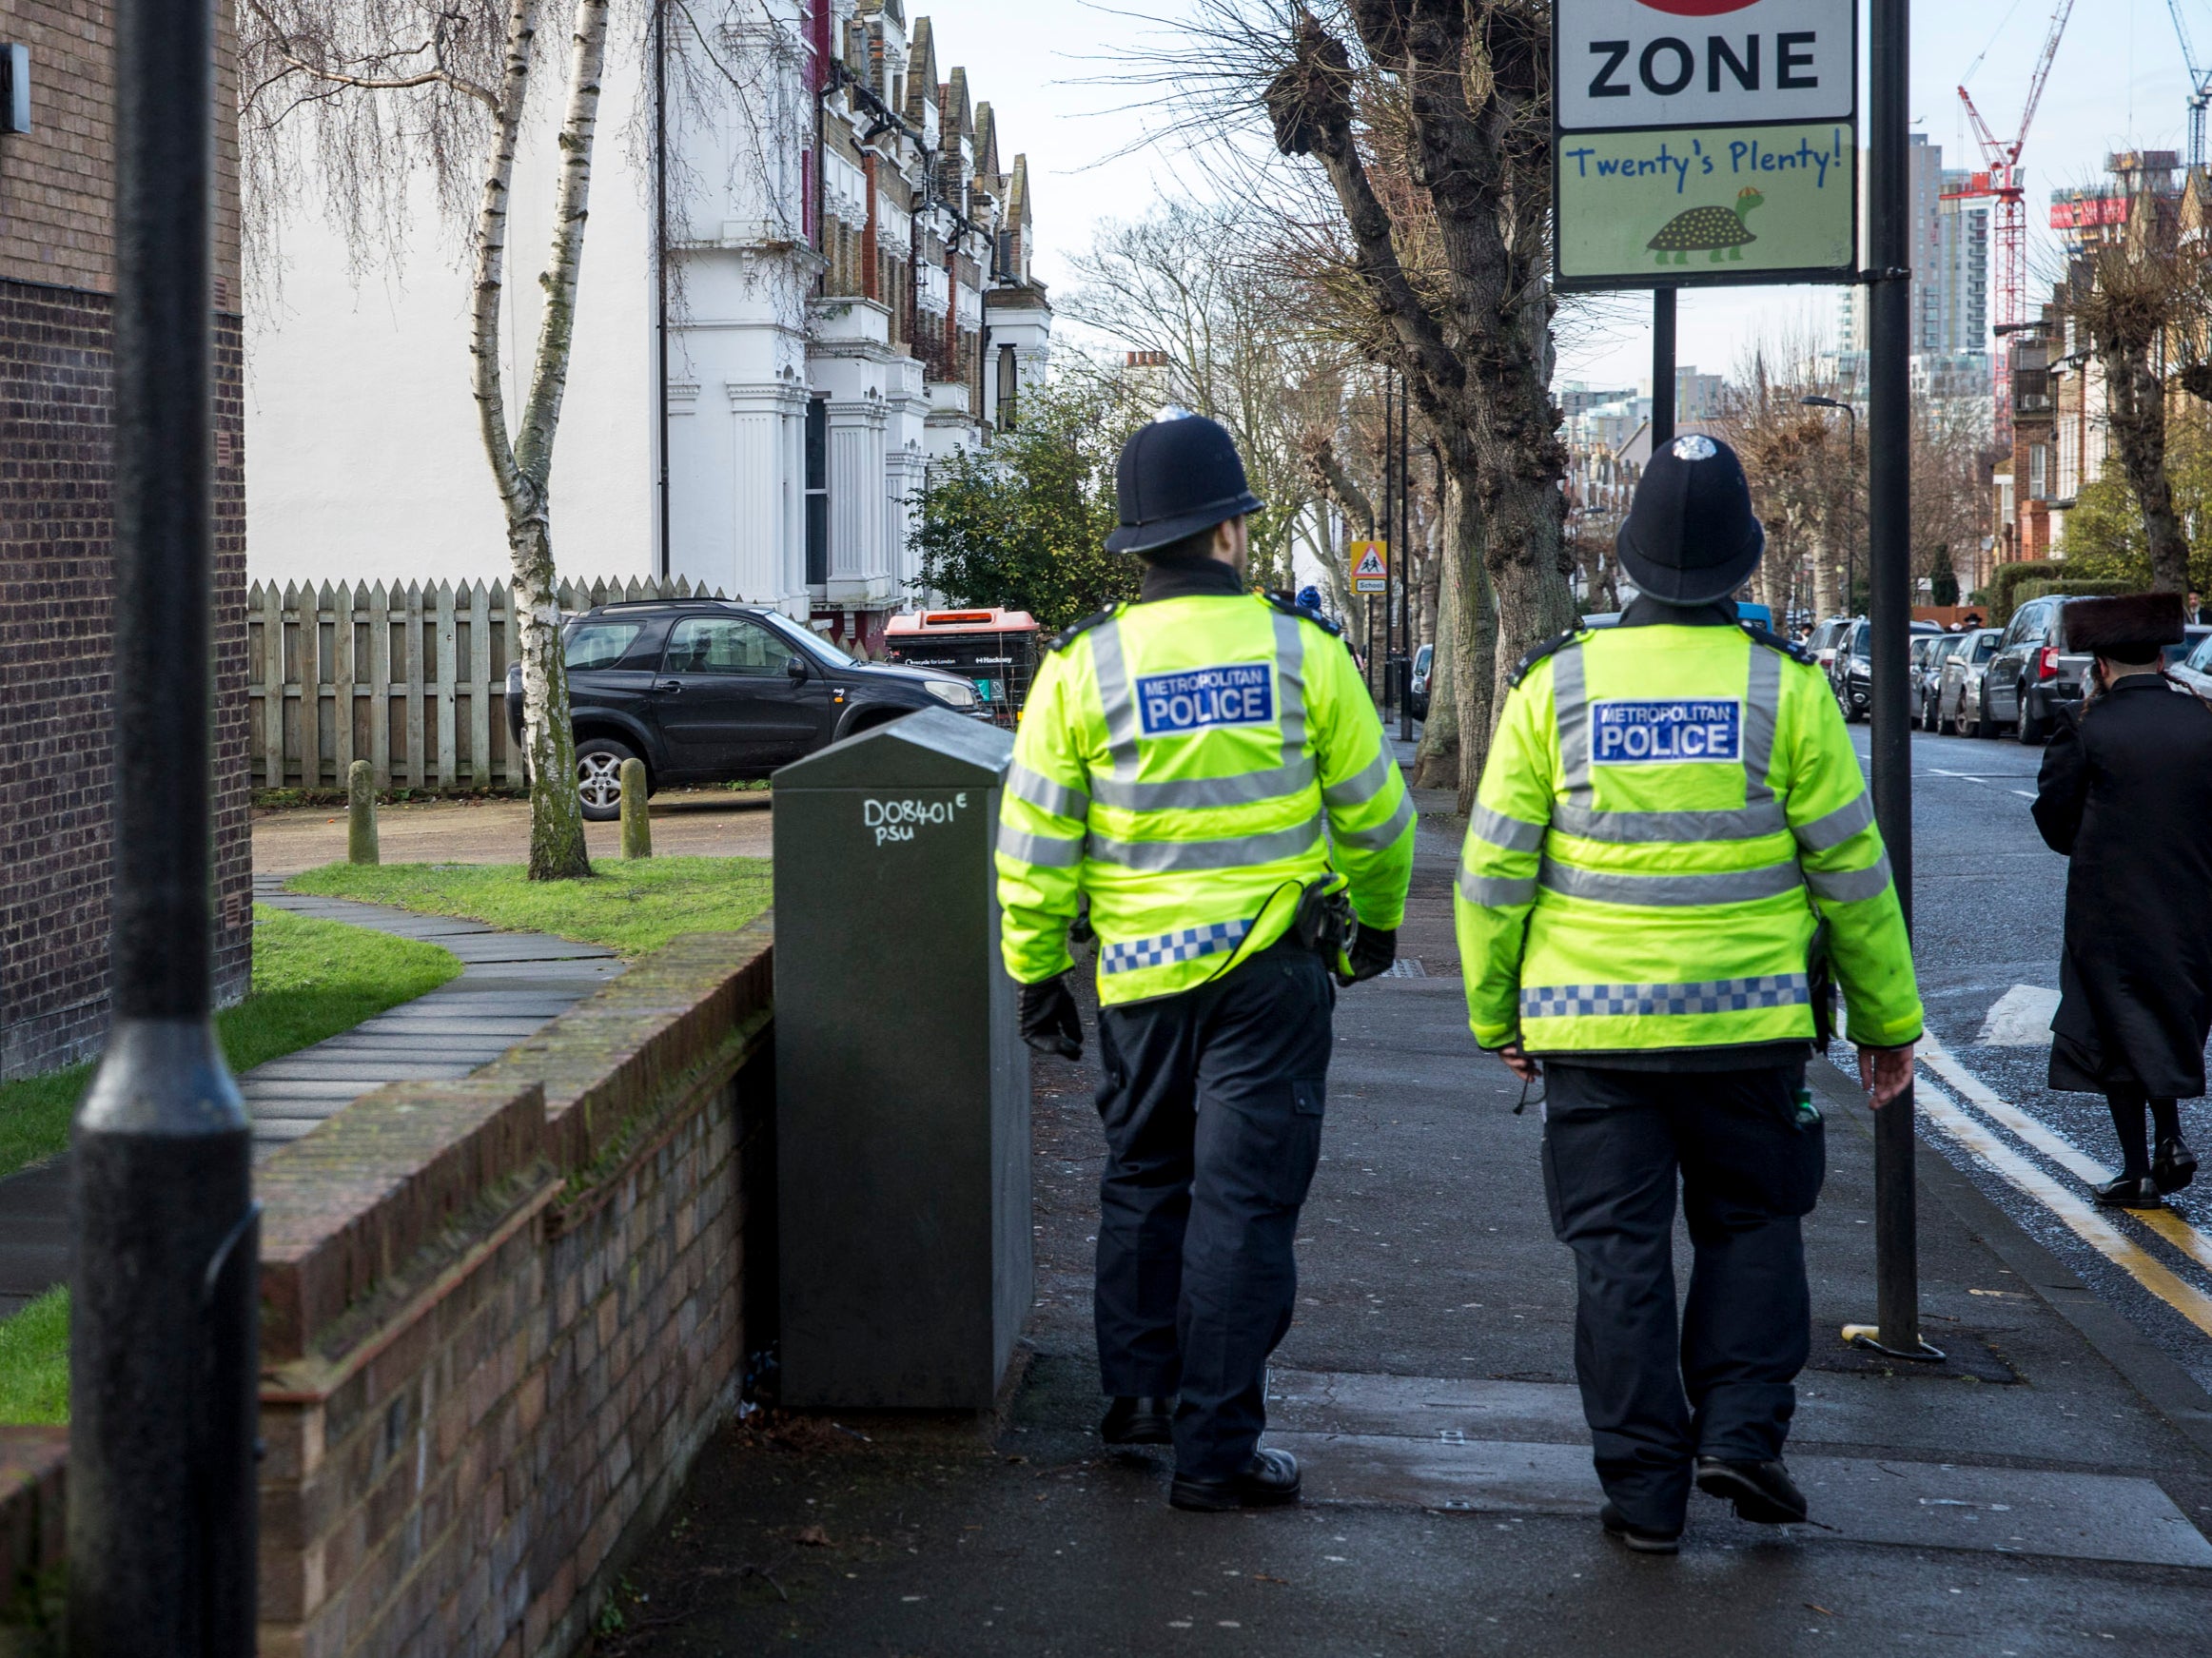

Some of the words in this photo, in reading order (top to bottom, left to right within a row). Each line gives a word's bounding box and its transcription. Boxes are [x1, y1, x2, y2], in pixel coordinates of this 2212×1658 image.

[1588, 31, 1818, 98] ZONE
[1566, 139, 1713, 194] Twenty's
[1729, 127, 1842, 188] Plenty!
[1145, 669, 1263, 696] METROPOLITAN
[1147, 687, 1264, 729] POLICE
[1601, 705, 1730, 724] METROPOLITAN
[1601, 723, 1730, 757] POLICE
